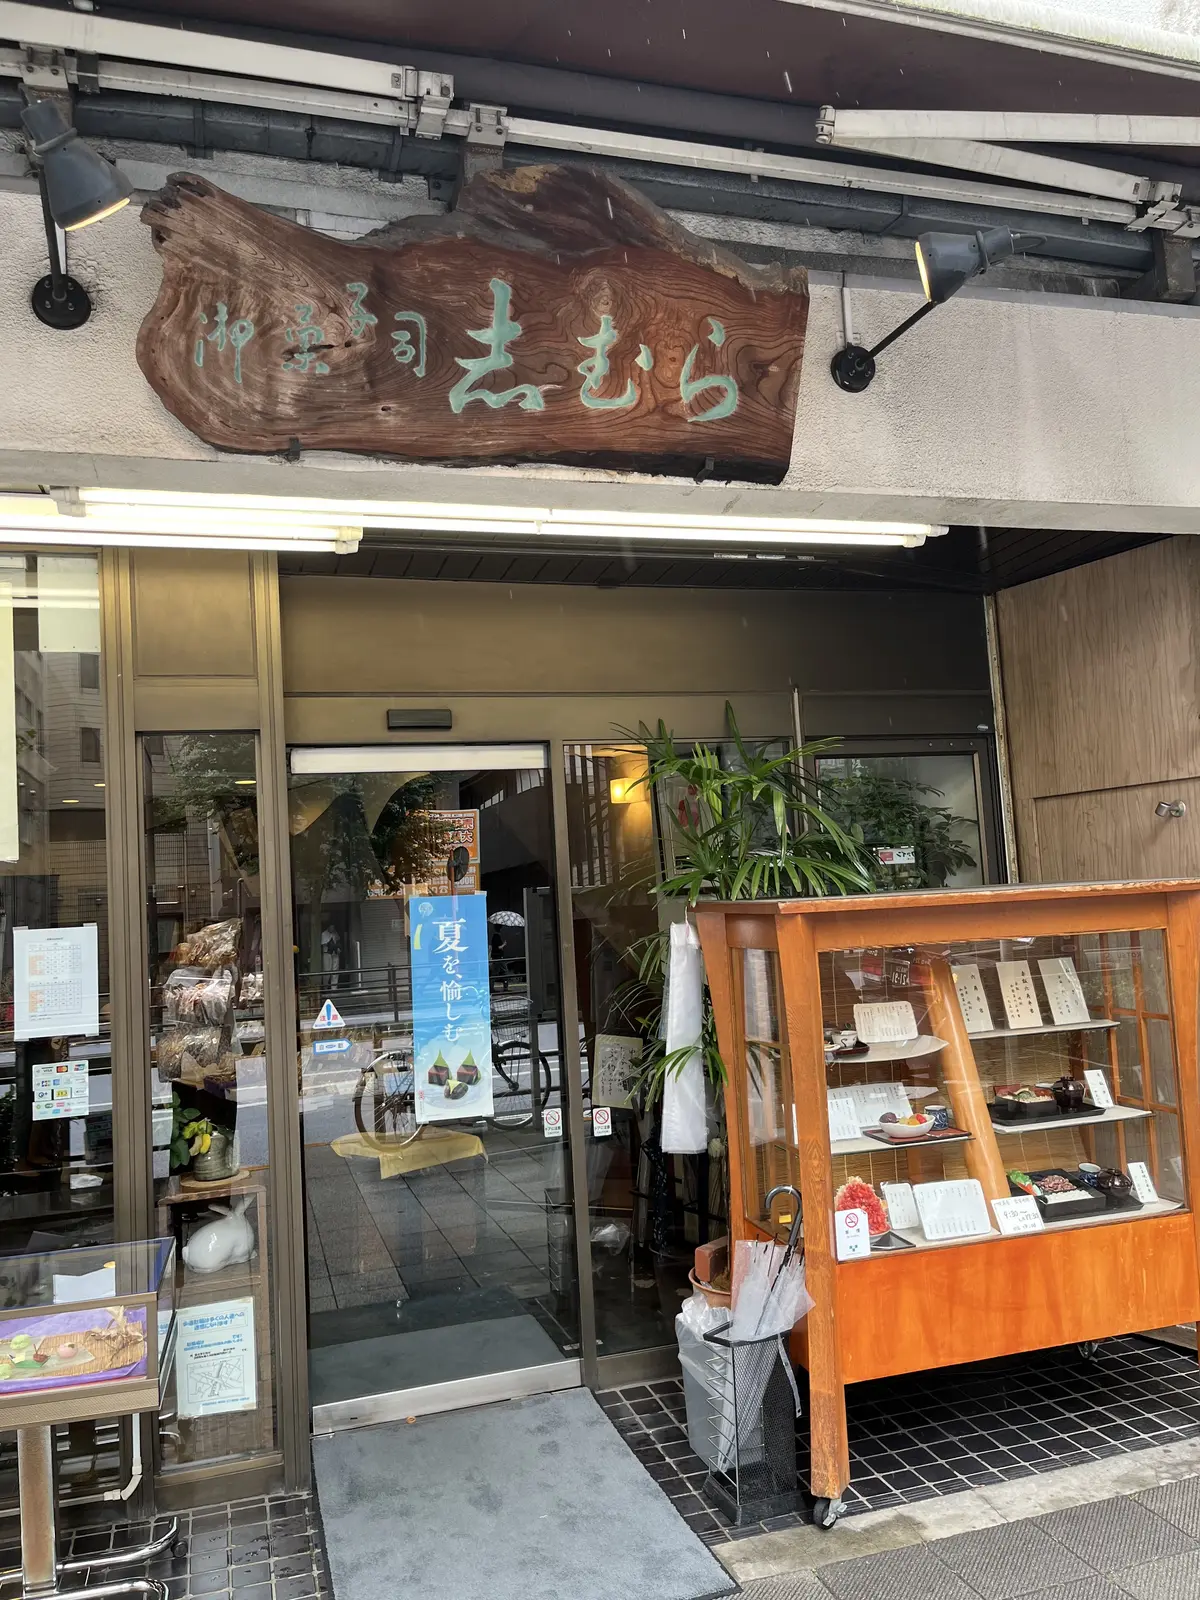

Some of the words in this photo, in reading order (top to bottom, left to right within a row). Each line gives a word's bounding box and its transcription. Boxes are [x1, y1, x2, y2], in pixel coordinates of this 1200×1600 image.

[432, 918, 469, 1042] 夏を、愉しむ
